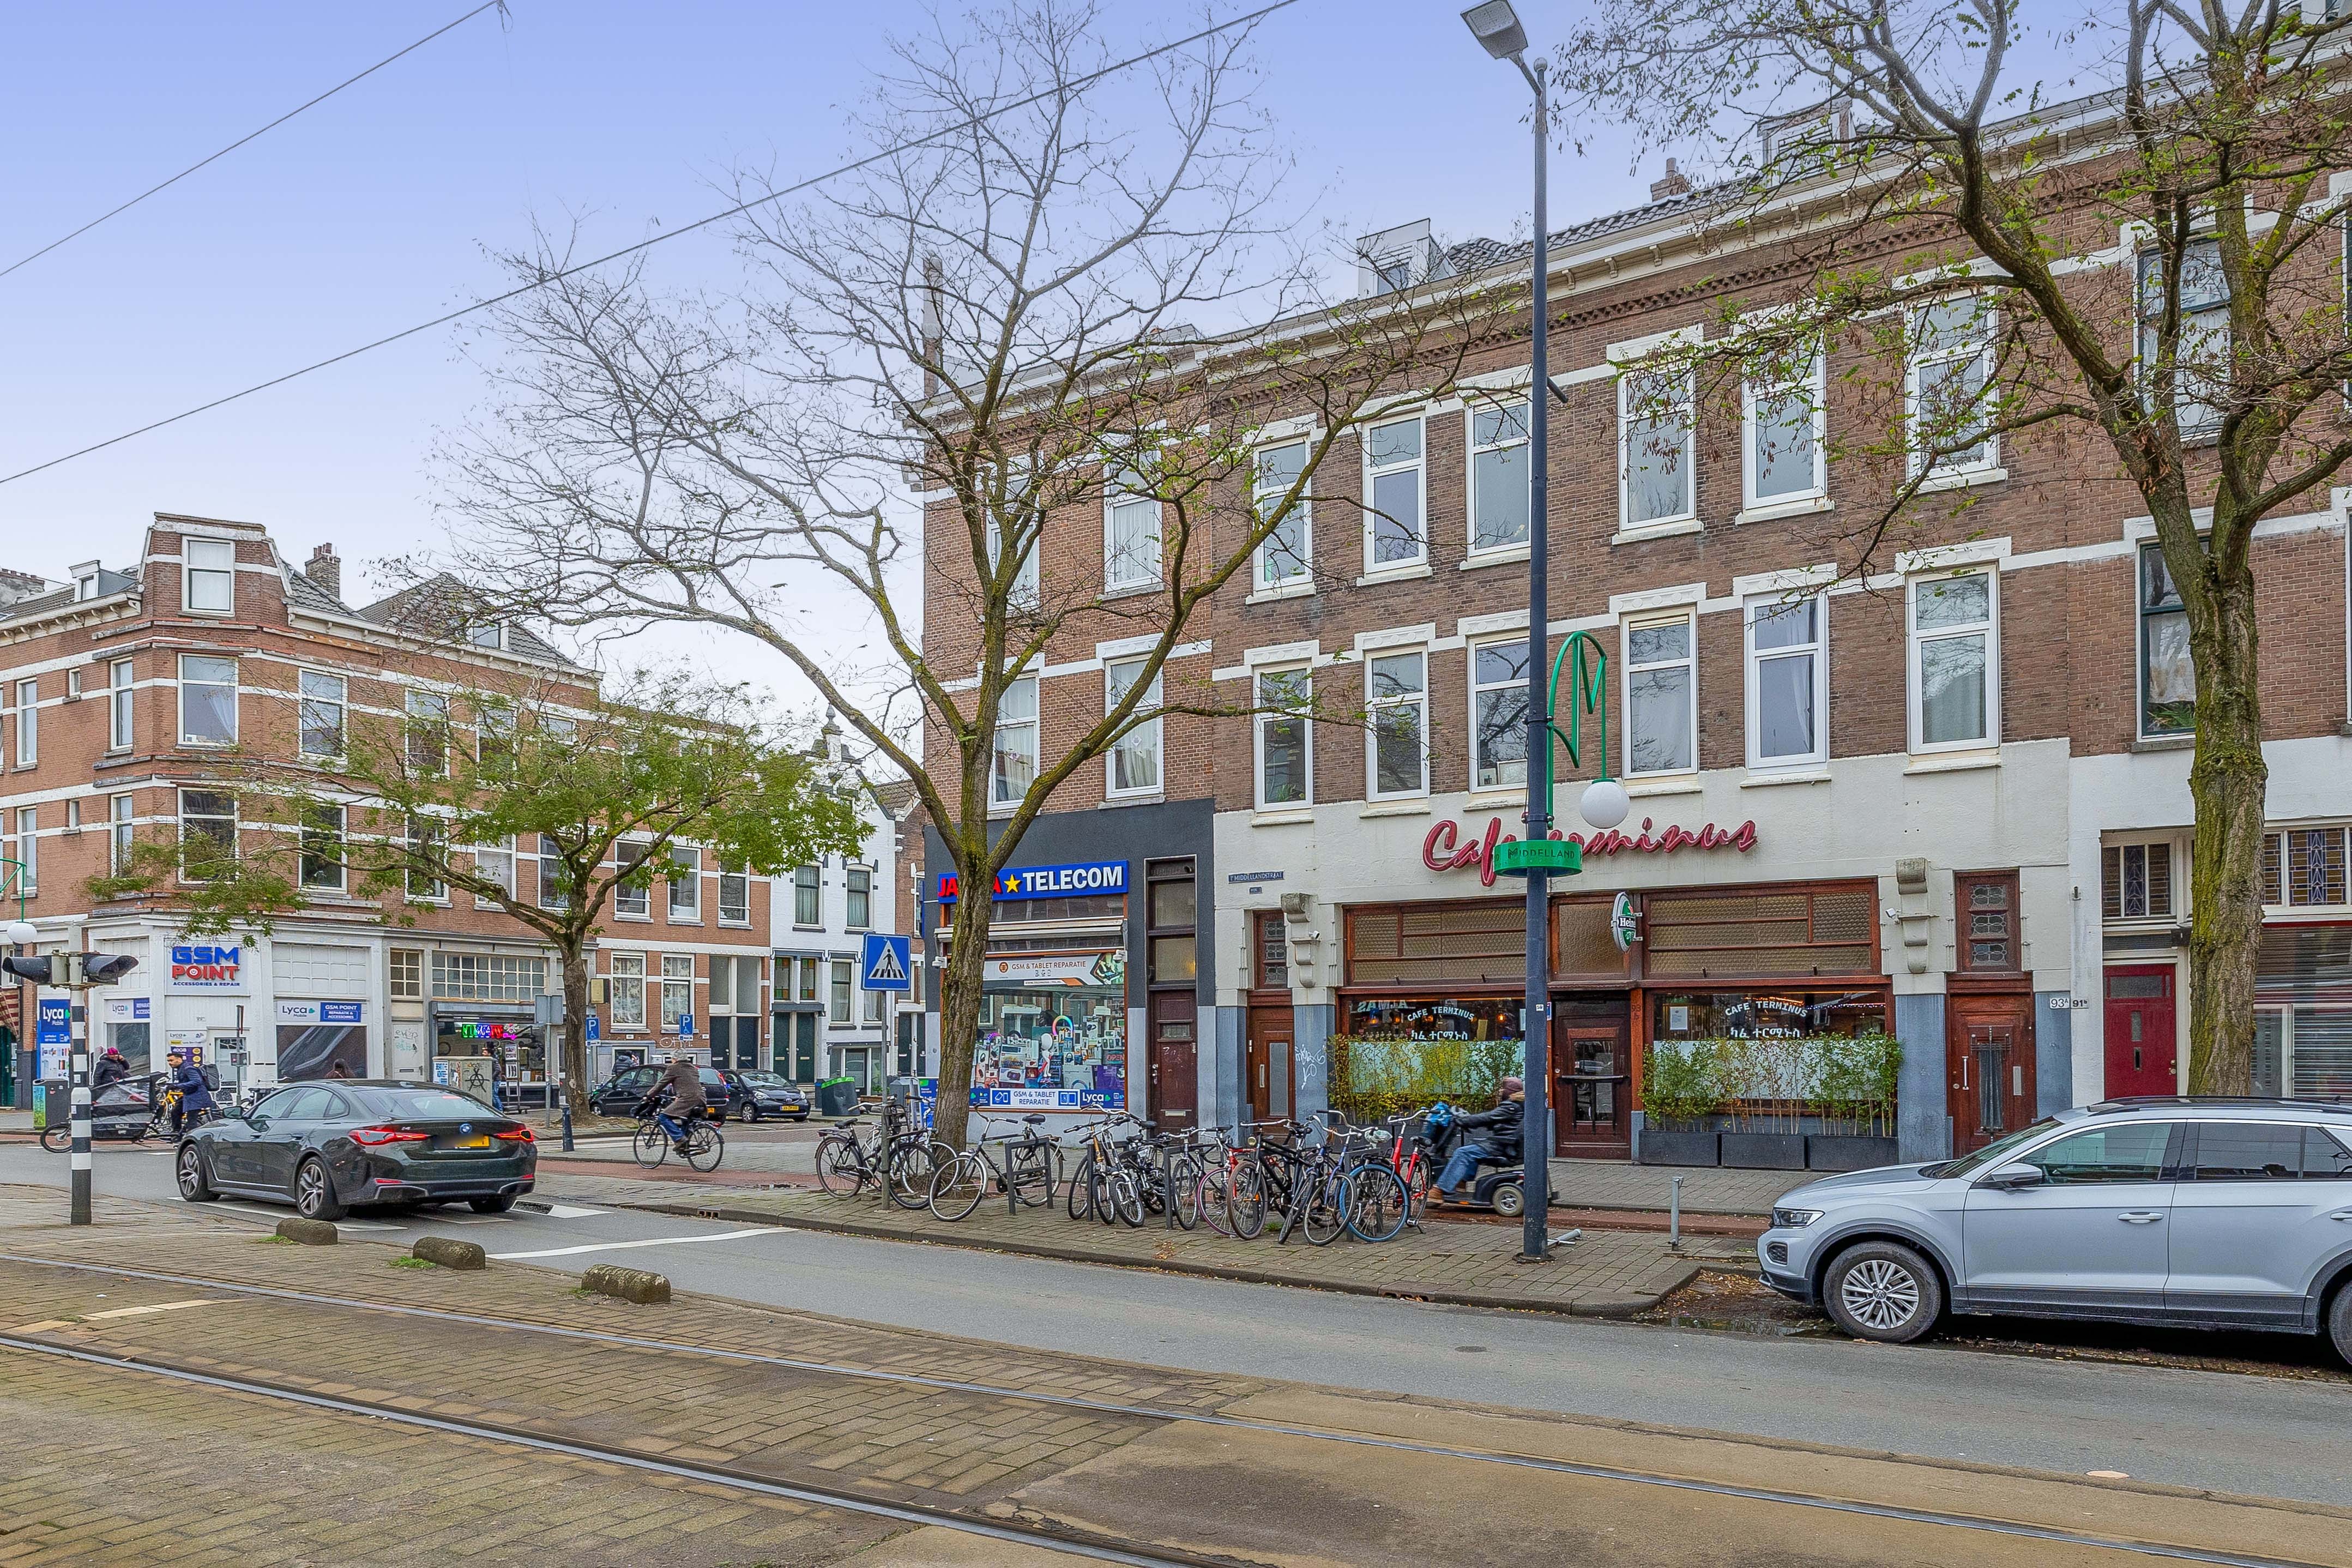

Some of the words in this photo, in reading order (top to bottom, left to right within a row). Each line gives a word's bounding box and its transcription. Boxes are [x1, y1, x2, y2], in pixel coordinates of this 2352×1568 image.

[1023, 866, 1122, 892] TELECOM
[1234, 872, 1282, 881] MIDDELLANDSTRAAT
[172, 946, 239, 964] GSM
[172, 965, 239, 980] POINT
[43, 1007, 64, 1022] Lyca
[112, 1004, 124, 1012] Lyca
[282, 1006, 307, 1014] Lyca
[1407, 1009, 1428, 1021] CAFE
[1432, 1006, 1474, 1021] TERMINUS
[1725, 1003, 1750, 1016] CAFE
[1756, 1001, 1808, 1017] TERMINUS
[1082, 1092, 1104, 1103] Lyca
